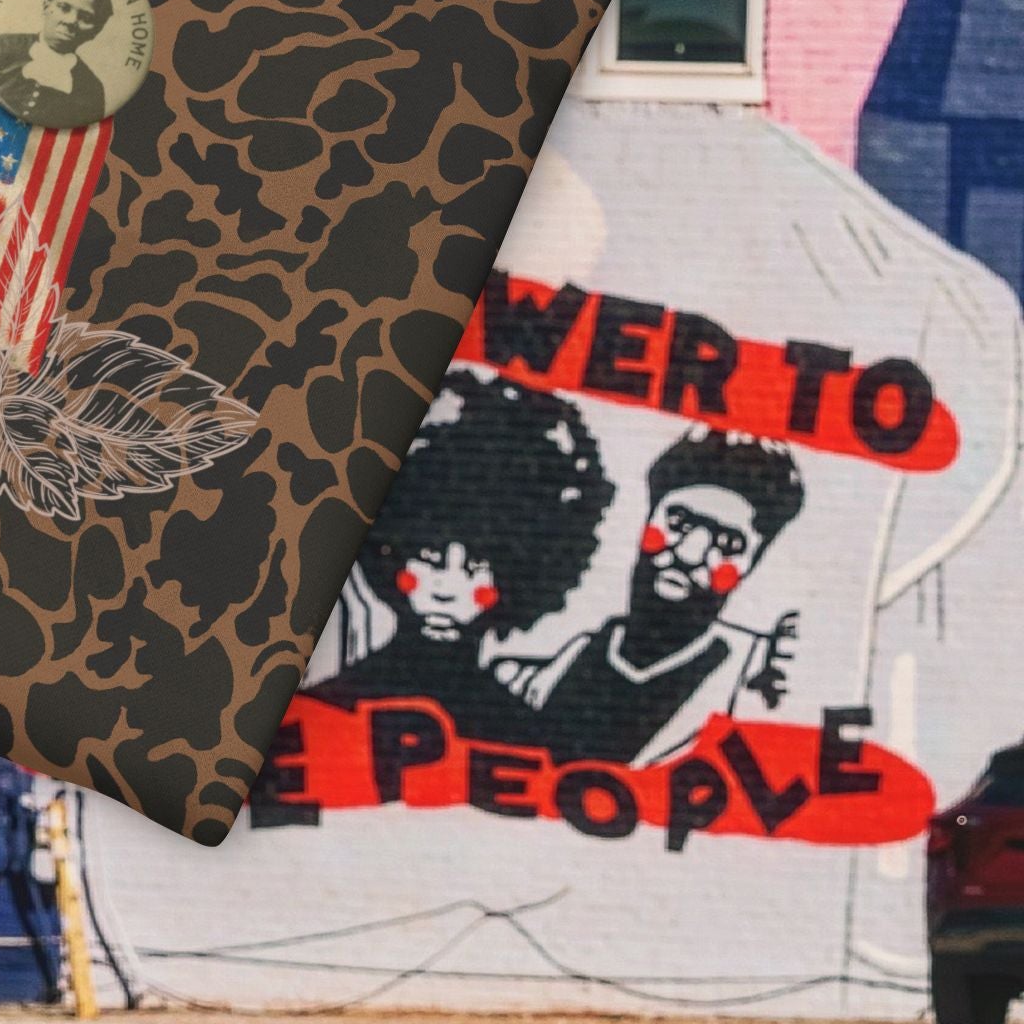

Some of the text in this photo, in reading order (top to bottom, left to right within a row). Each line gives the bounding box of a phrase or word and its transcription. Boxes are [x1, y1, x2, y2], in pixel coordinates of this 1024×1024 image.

[125, 12, 150, 71] HOME
[785, 338, 934, 455] TO
[369, 704, 882, 855] PEOPLE
